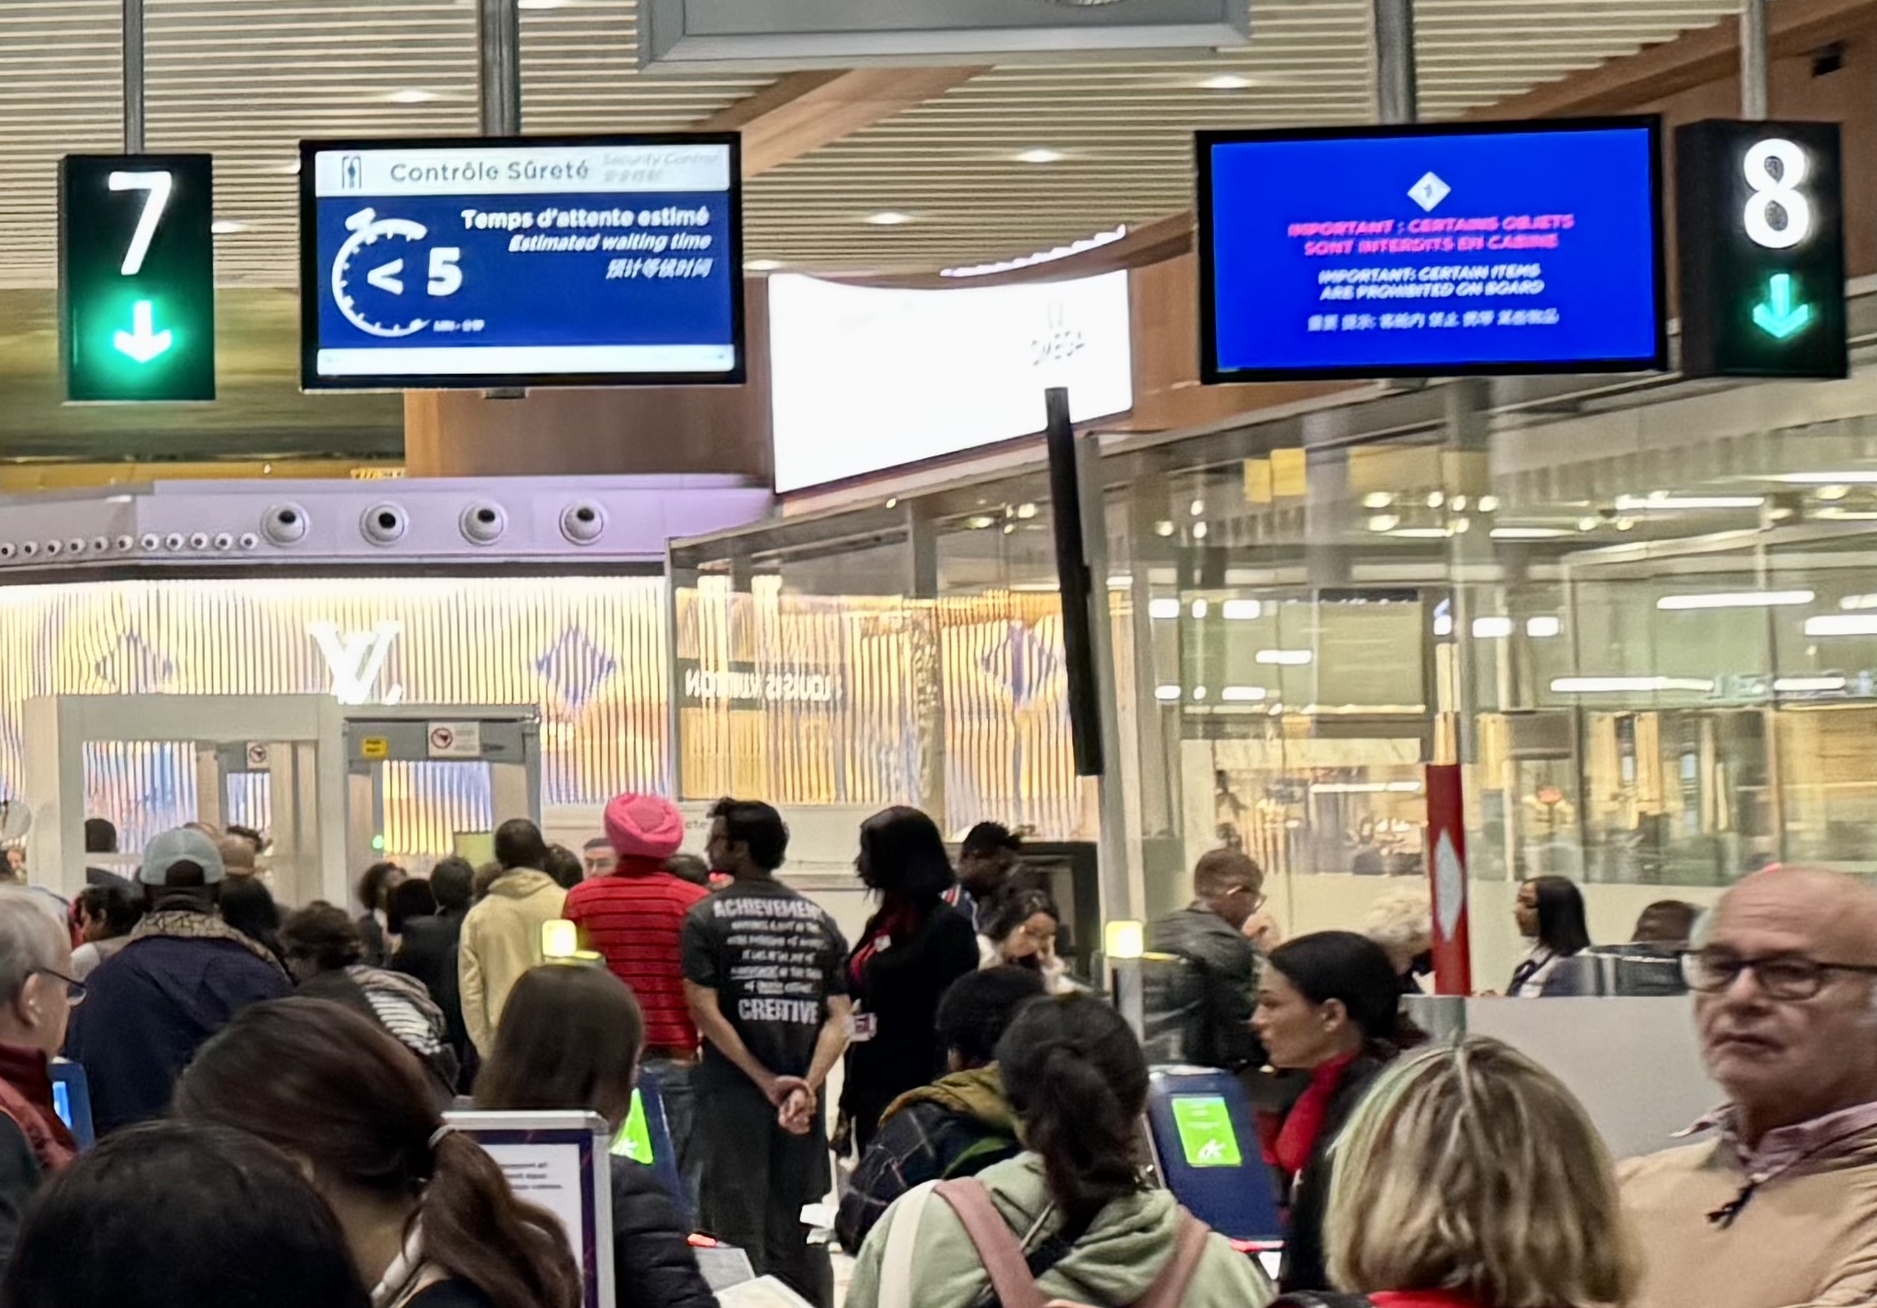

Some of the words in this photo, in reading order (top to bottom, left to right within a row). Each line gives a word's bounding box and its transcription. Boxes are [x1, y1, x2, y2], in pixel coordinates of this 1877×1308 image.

[390, 161, 499, 183] Contrôle
[508, 160, 590, 181] Sûreté
[1743, 137, 1810, 249] 8
[107, 170, 173, 276] 7
[461, 209, 533, 231] Temps
[536, 207, 634, 229] d'attente
[638, 205, 711, 227] estimé
[1288, 219, 1395, 237] IMPORTANT
[508, 233, 598, 252] Estimated
[601, 233, 667, 254] waiting
[670, 232, 712, 250] time
[427, 247, 463, 296] 5
